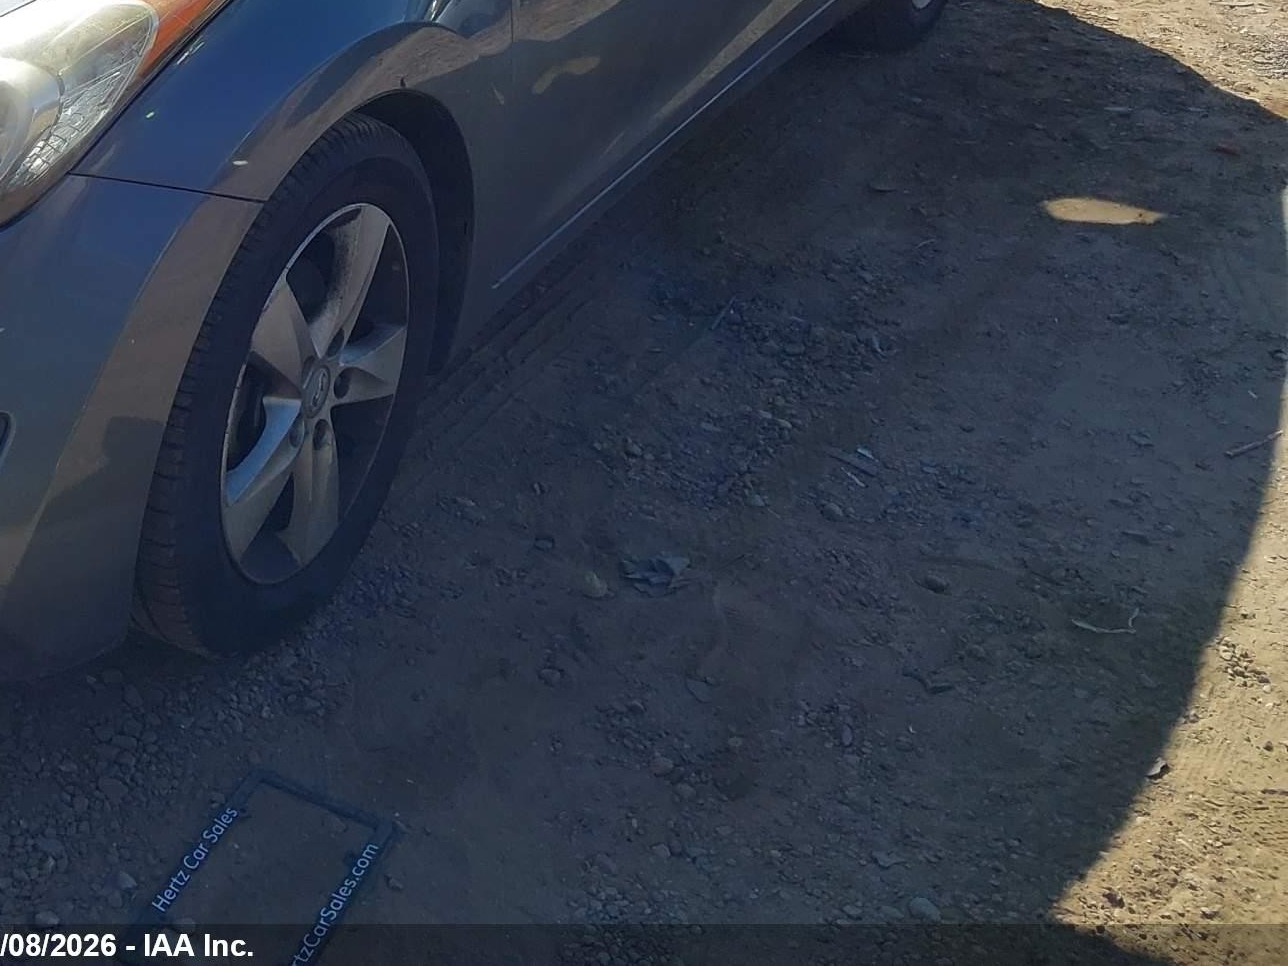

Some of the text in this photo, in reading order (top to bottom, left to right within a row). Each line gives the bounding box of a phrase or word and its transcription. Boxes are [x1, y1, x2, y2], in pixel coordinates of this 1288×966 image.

[151, 807, 238, 912] Hertz Car Sales
